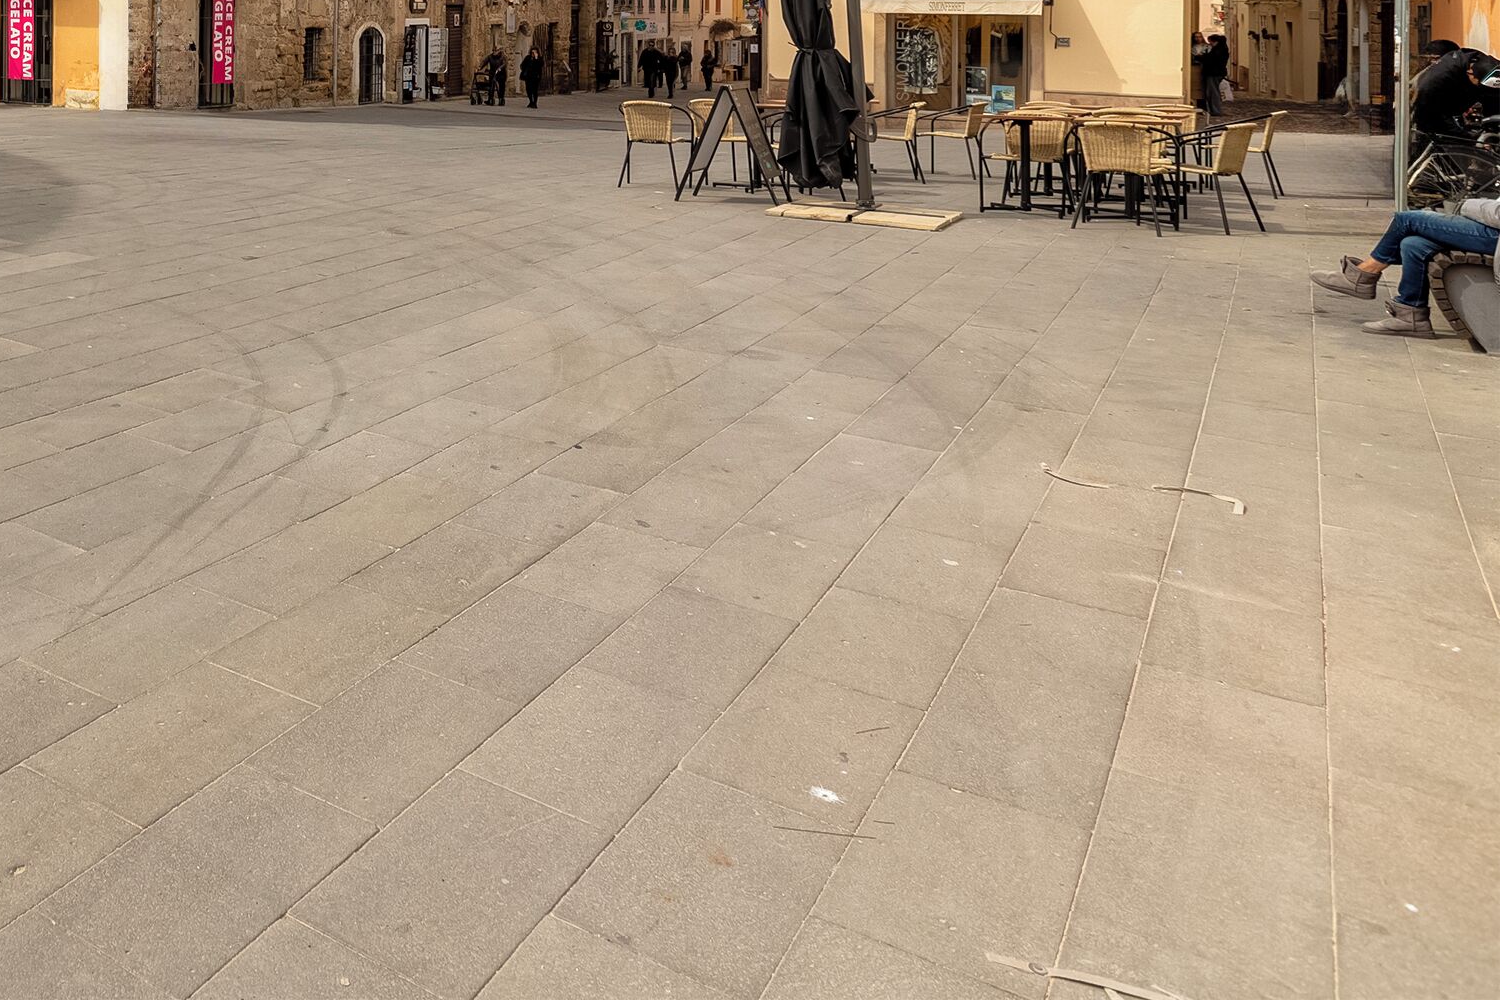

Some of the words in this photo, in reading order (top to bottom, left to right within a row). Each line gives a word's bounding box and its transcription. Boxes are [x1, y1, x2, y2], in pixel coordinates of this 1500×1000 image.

[22, 21, 33, 78] CREAM
[214, 0, 223, 62] GELATO
[224, 25, 233, 81] CREAM
